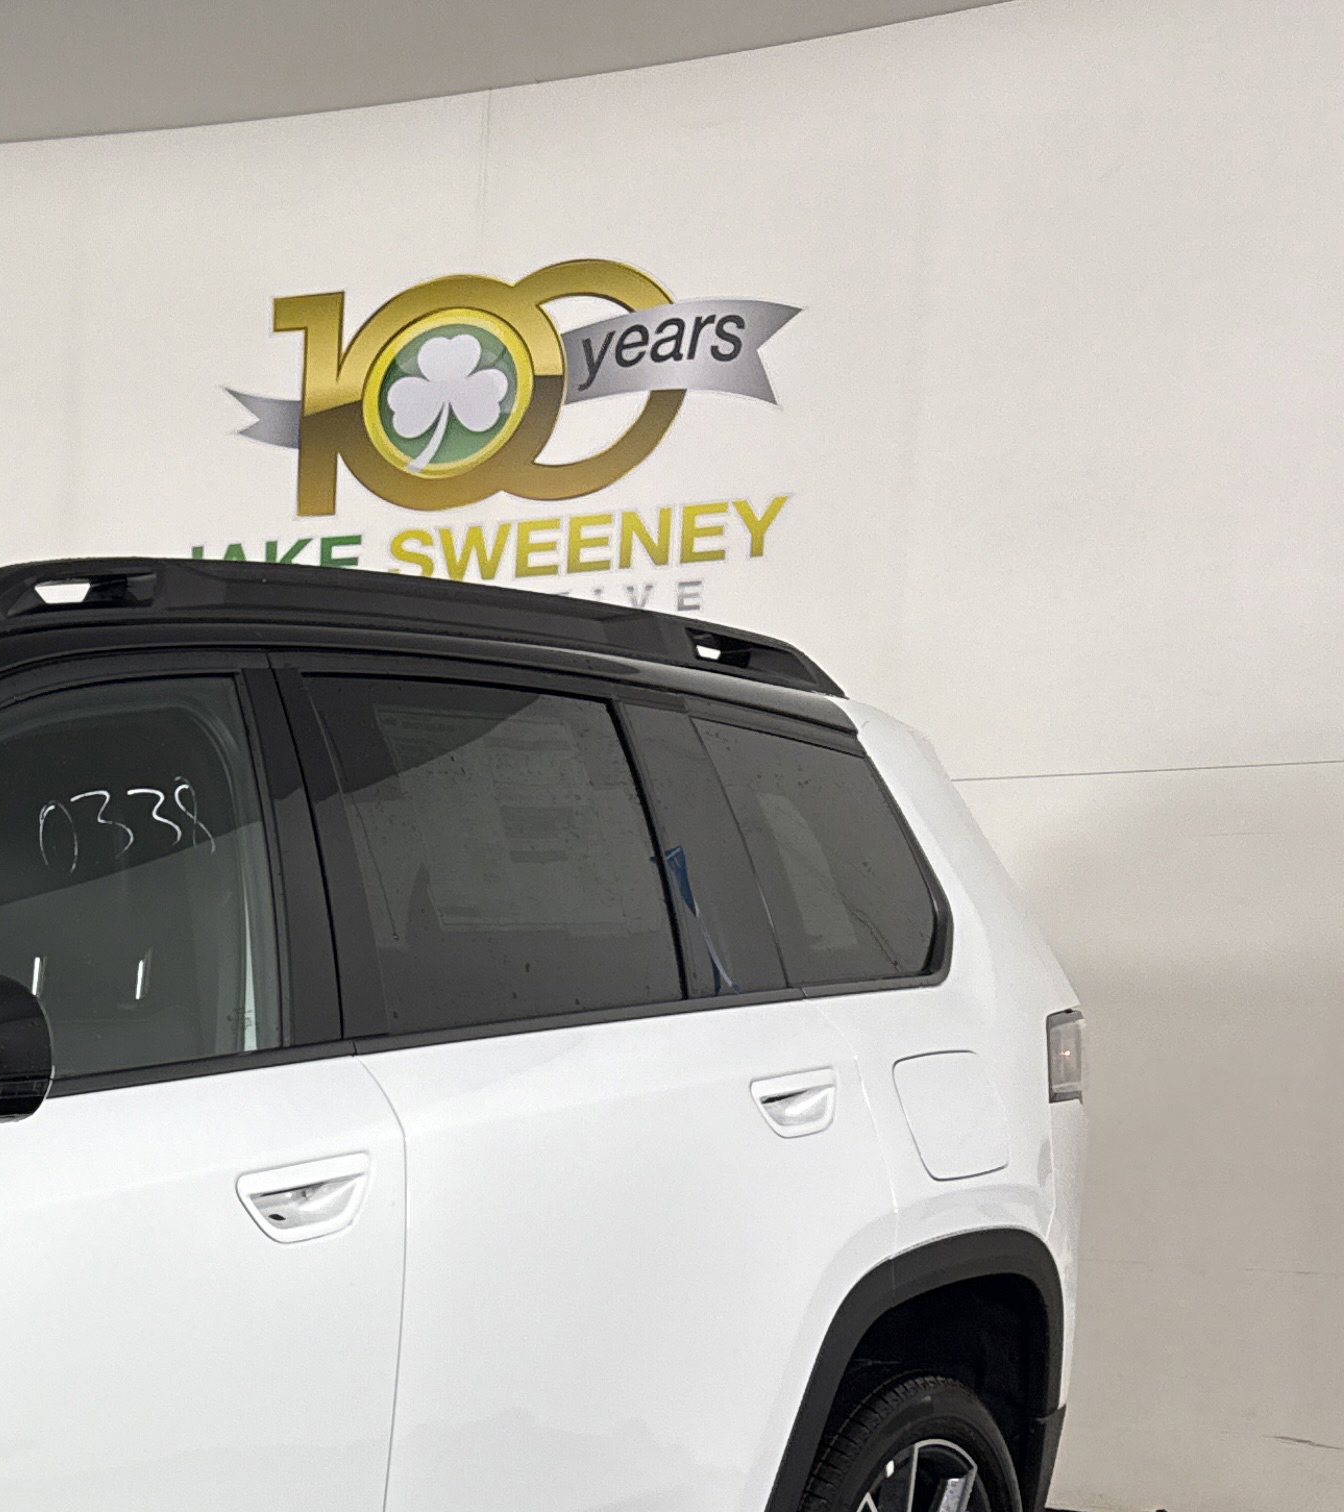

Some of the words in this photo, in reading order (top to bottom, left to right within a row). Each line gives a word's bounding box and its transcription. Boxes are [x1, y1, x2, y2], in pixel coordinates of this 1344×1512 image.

[273, 258, 687, 517] 100
[578, 312, 746, 391] years
[390, 496, 789, 581] SWEENEY
